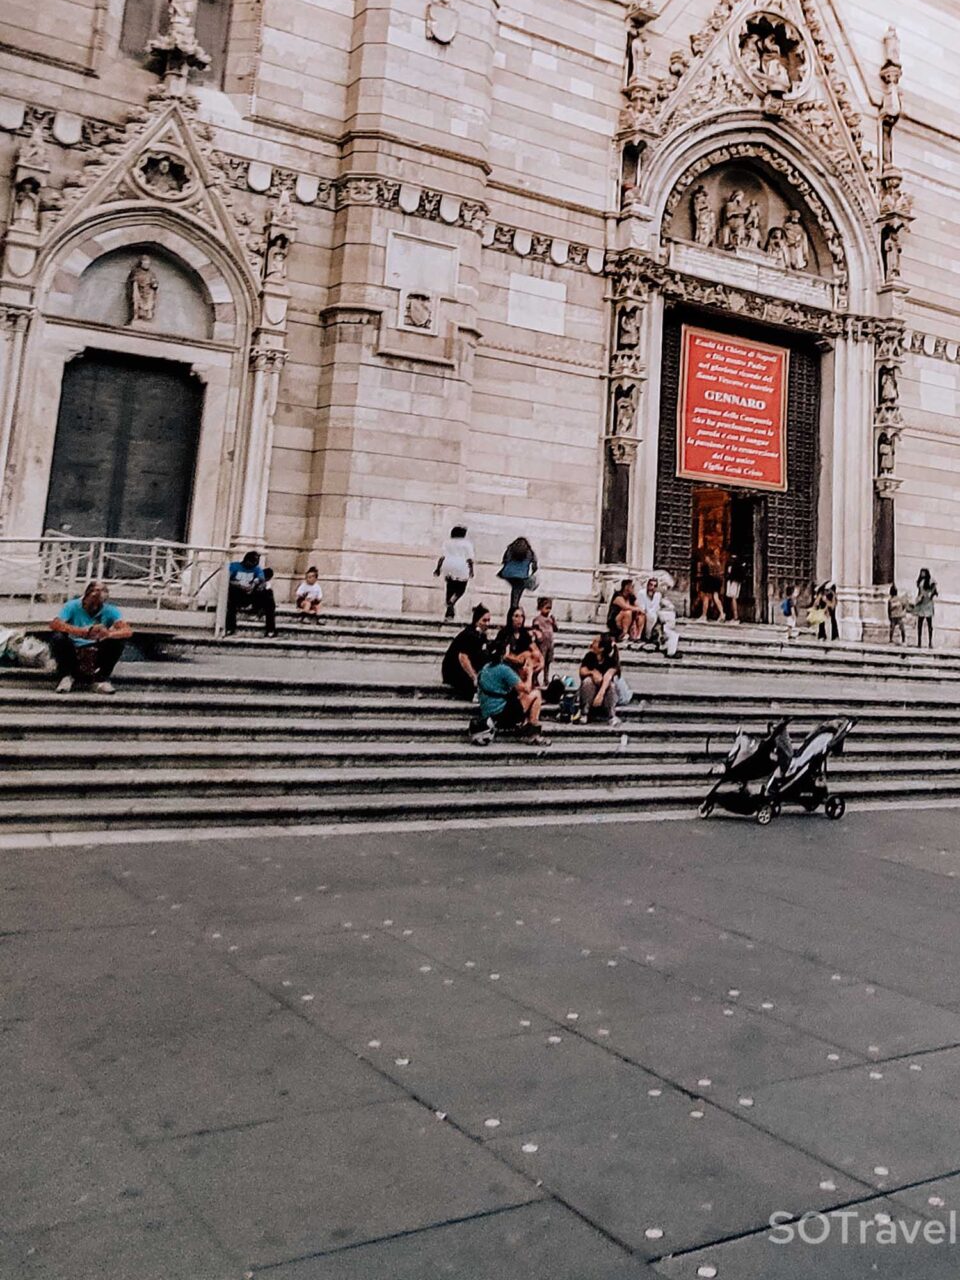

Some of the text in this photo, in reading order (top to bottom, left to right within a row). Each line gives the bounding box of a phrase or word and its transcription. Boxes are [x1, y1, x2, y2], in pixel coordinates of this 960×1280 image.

[717, 343, 724, 351] la
[747, 350, 755, 358] di
[755, 352, 777, 363] Napoli
[704, 389, 767, 410] GENNARO
